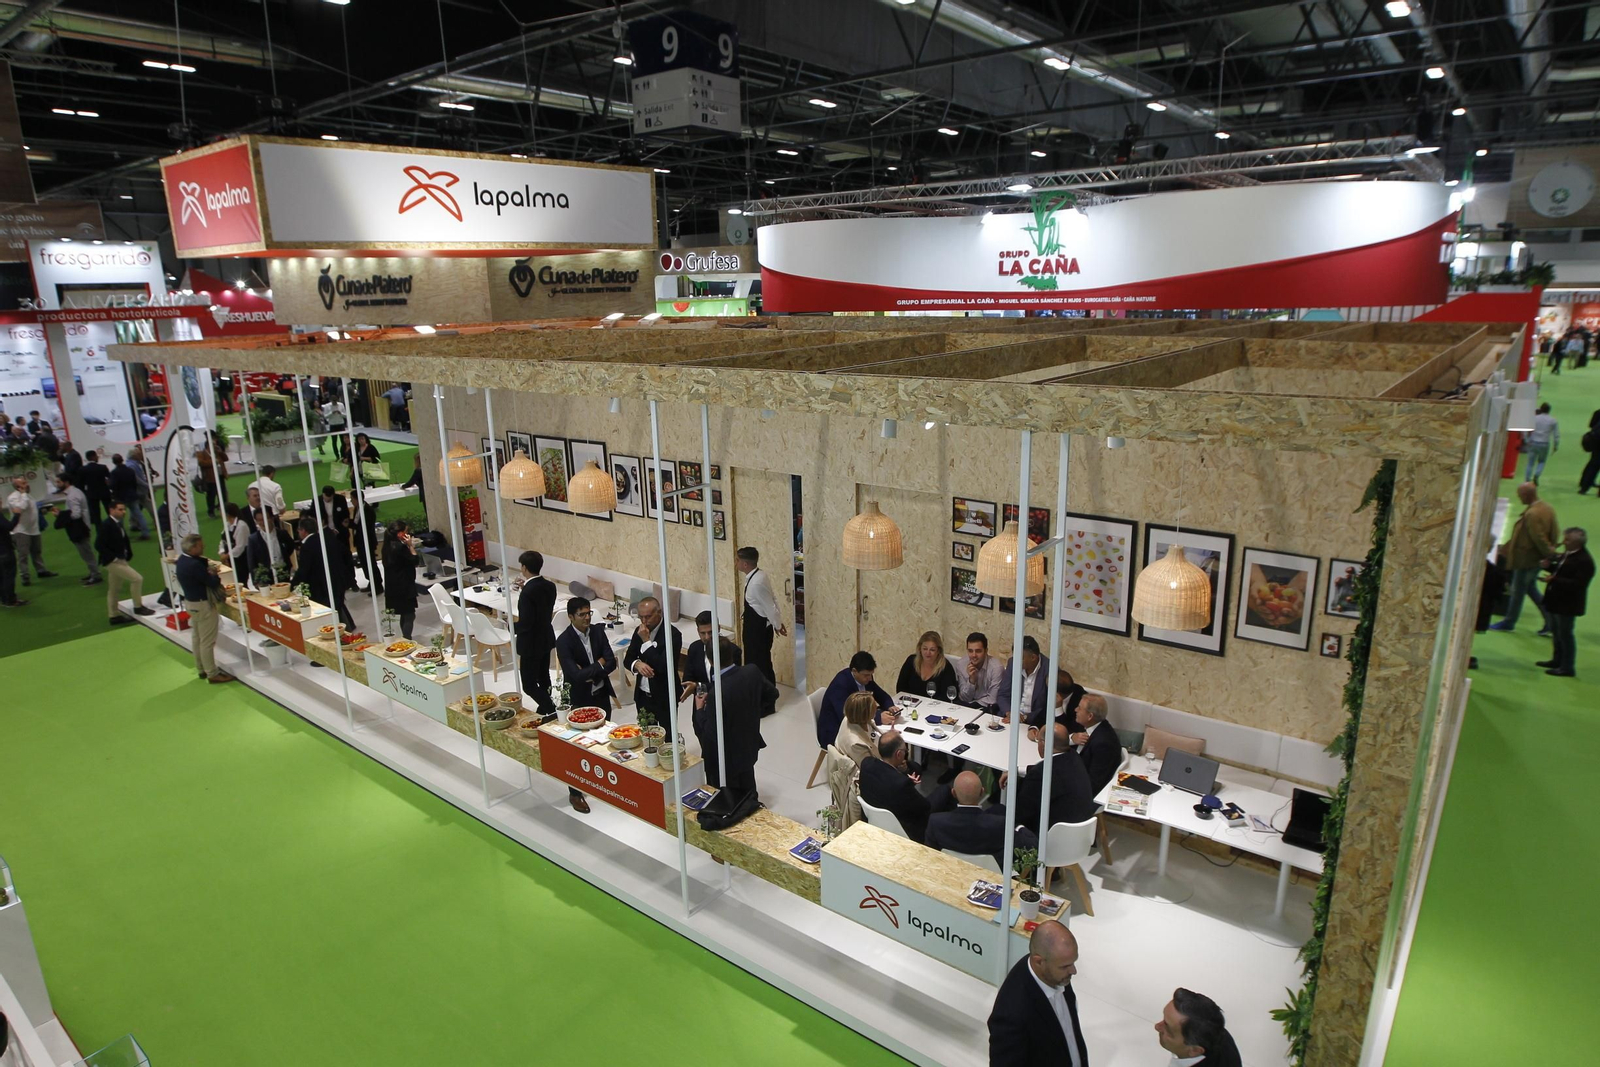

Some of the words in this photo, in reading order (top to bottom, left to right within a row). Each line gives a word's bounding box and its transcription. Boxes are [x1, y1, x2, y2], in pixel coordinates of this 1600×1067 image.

[662, 25, 679, 63] 9
[718, 33, 733, 69] 9
[644, 104, 662, 115] Salida
[203, 182, 251, 219] lapalma
[473, 181, 570, 216] lapalma
[40, 248, 151, 270] fresgarrido
[685, 250, 740, 271] Grufesa
[998, 250, 1030, 259] GRUPO
[998, 260, 1024, 276] LA
[1028, 254, 1081, 275] CAÑA
[36, 309, 107, 321] productora
[398, 679, 429, 701] lapalma
[564, 769, 639, 808] www.granadalapalma.com
[907, 909, 983, 956] lapalma
